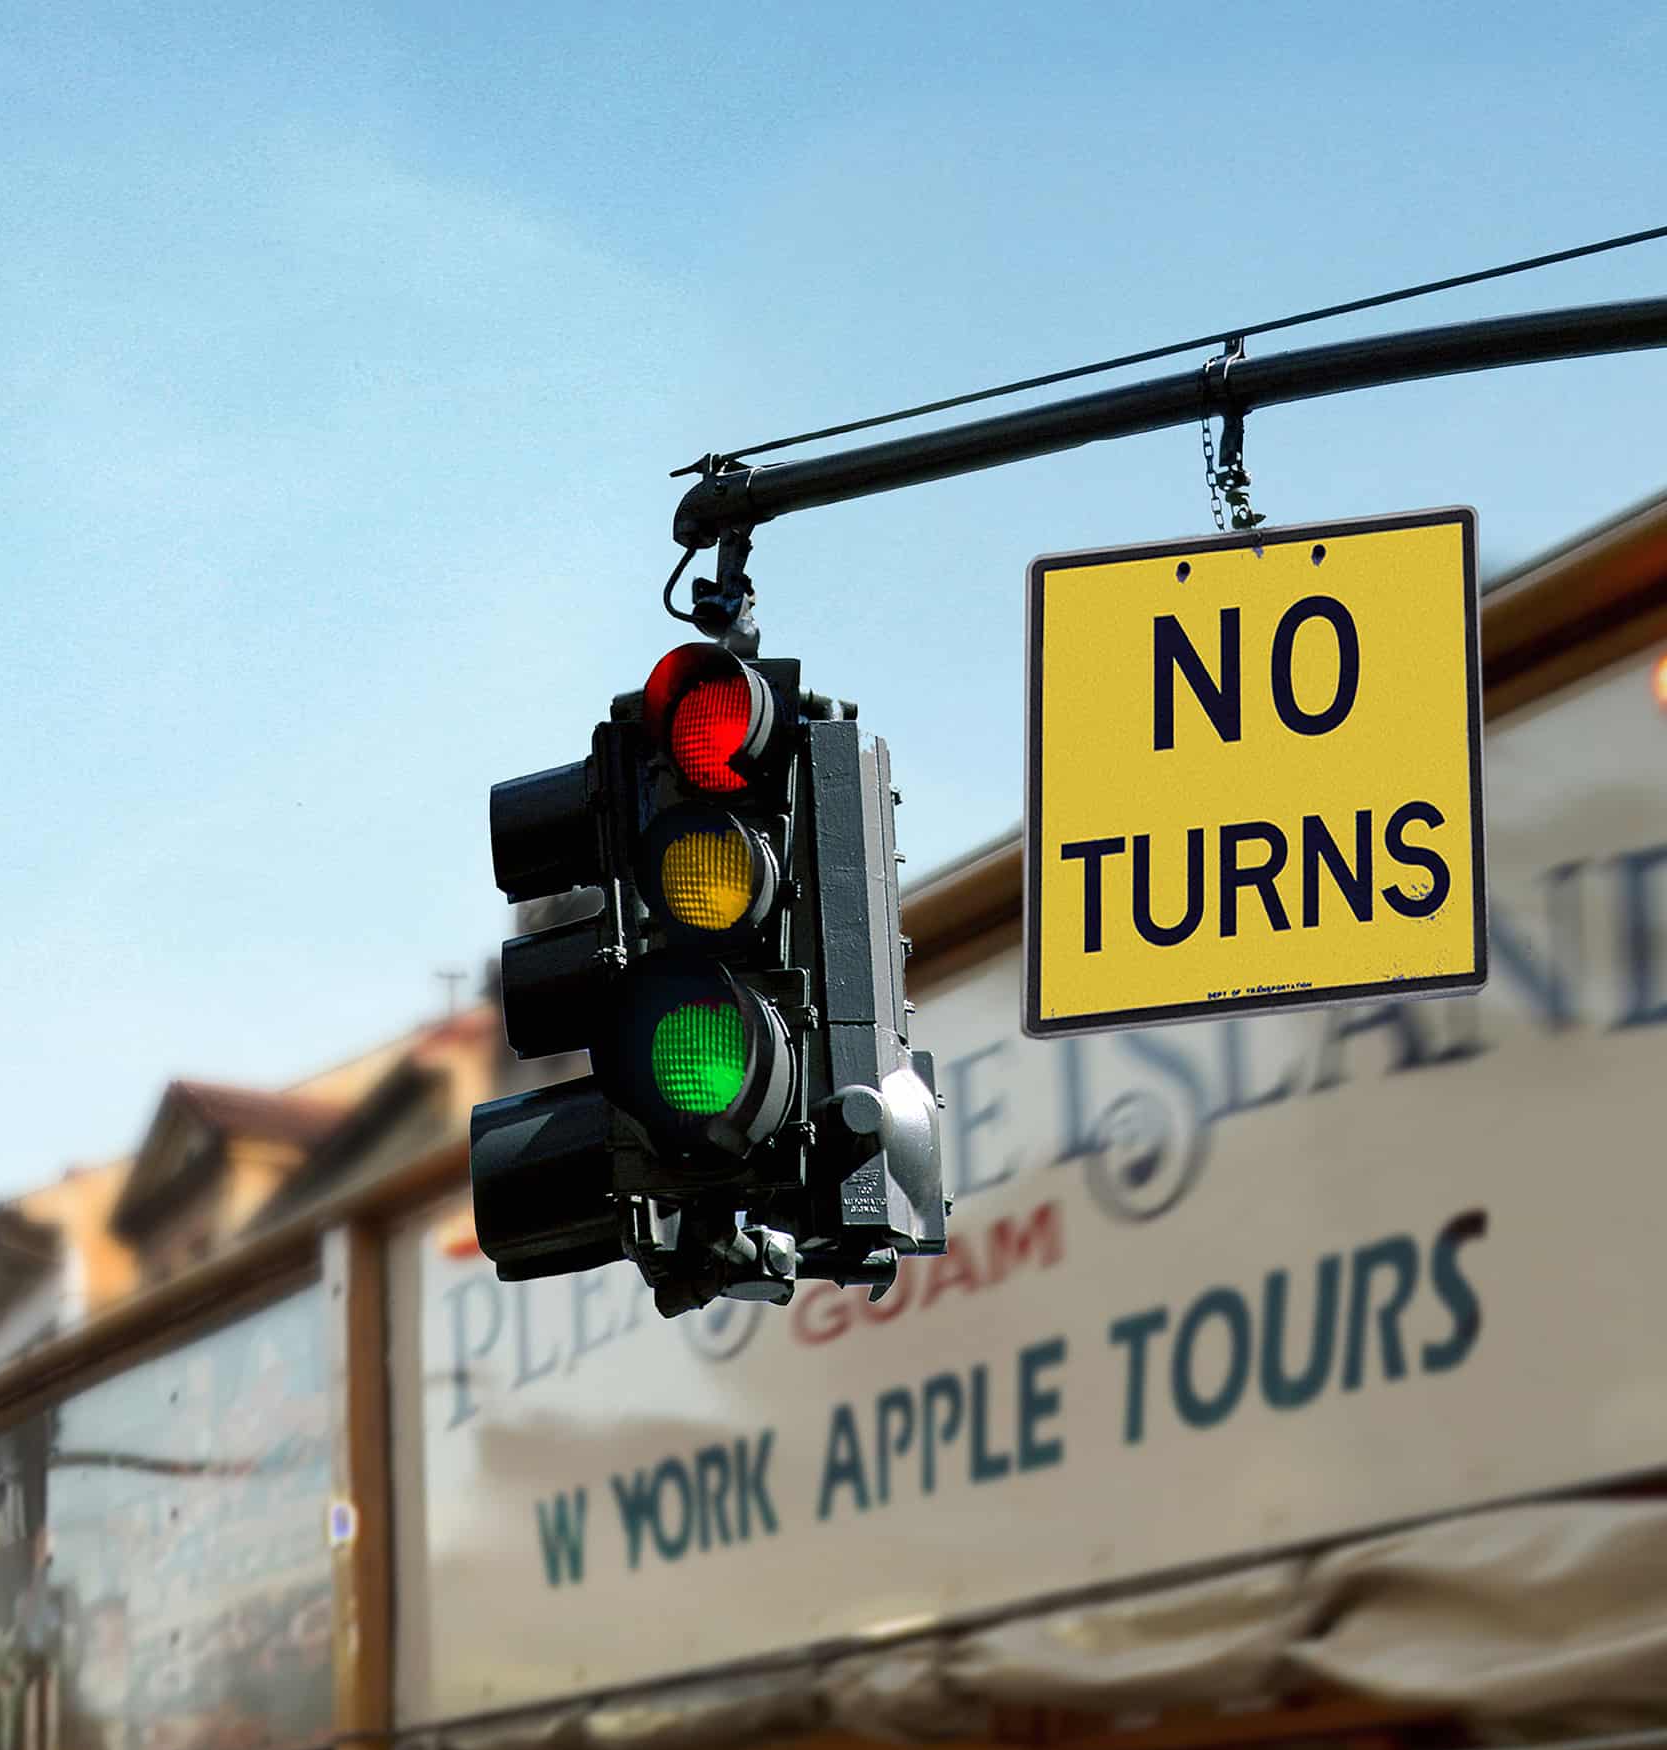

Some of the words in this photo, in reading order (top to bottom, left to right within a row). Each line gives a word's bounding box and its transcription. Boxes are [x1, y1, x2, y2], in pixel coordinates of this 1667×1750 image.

[1153, 594, 1360, 751] NO
[1060, 800, 1451, 954] TURNS
[1231, 988, 1241, 996] OF
[611, 1432, 779, 1572] YORK
[815, 1338, 1065, 1520] APPLE
[1110, 1209, 1488, 1444] TOURS
